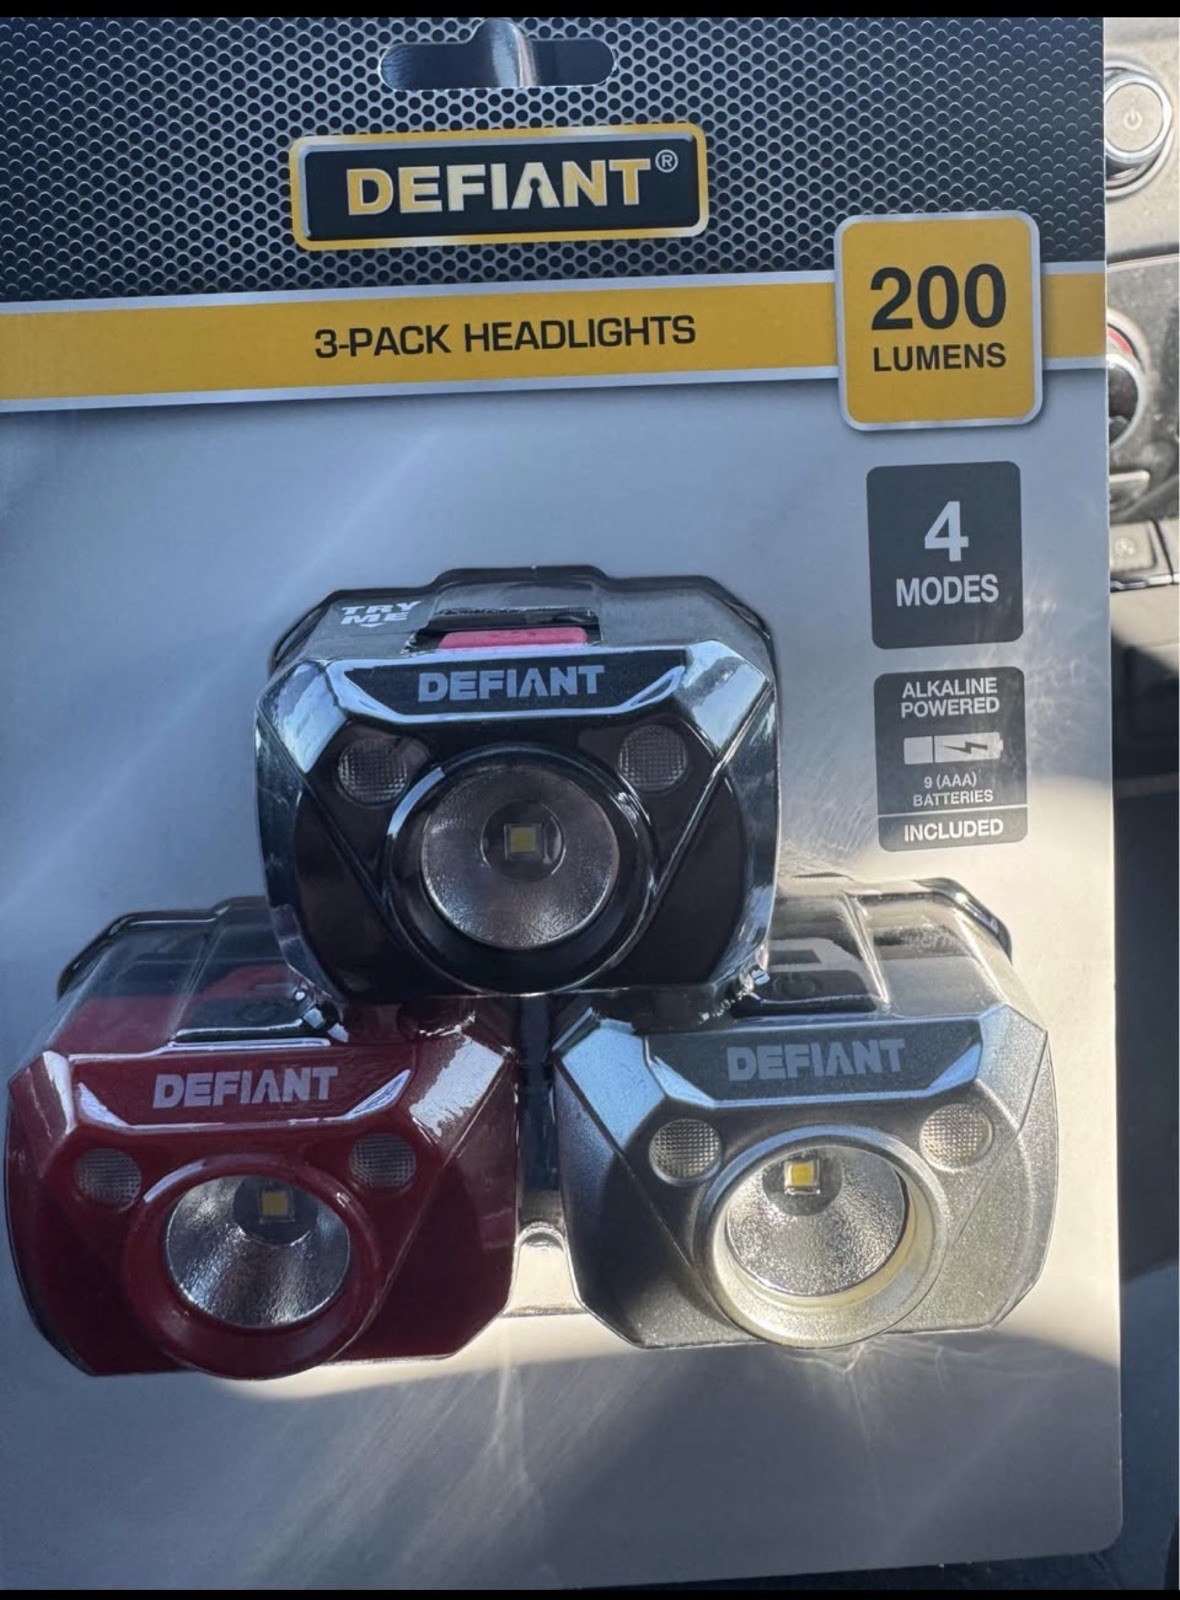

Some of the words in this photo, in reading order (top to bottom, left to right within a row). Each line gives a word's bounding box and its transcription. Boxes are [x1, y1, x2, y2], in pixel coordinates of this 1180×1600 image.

[870, 264, 1006, 330] 200
[315, 325, 450, 358] 3-PACK
[465, 315, 695, 352] HEADLIGHTS
[873, 343, 1006, 371] LUMENS
[924, 501, 969, 562] 4
[896, 575, 998, 607] MODES
[340, 611, 409, 626] ME
[341, 601, 421, 615] TRY
[418, 664, 605, 703] DEFIANT
[902, 677, 997, 697] ALKALINE
[901, 698, 999, 718] POWERED
[924, 776, 932, 788] 9
[936, 771, 977, 788] (AAA)
[913, 790, 994, 807] BATTERIES
[905, 819, 1003, 842] INCLUDED
[727, 1038, 906, 1082] DEFIANT
[152, 1066, 338, 1110] DEFIANT
